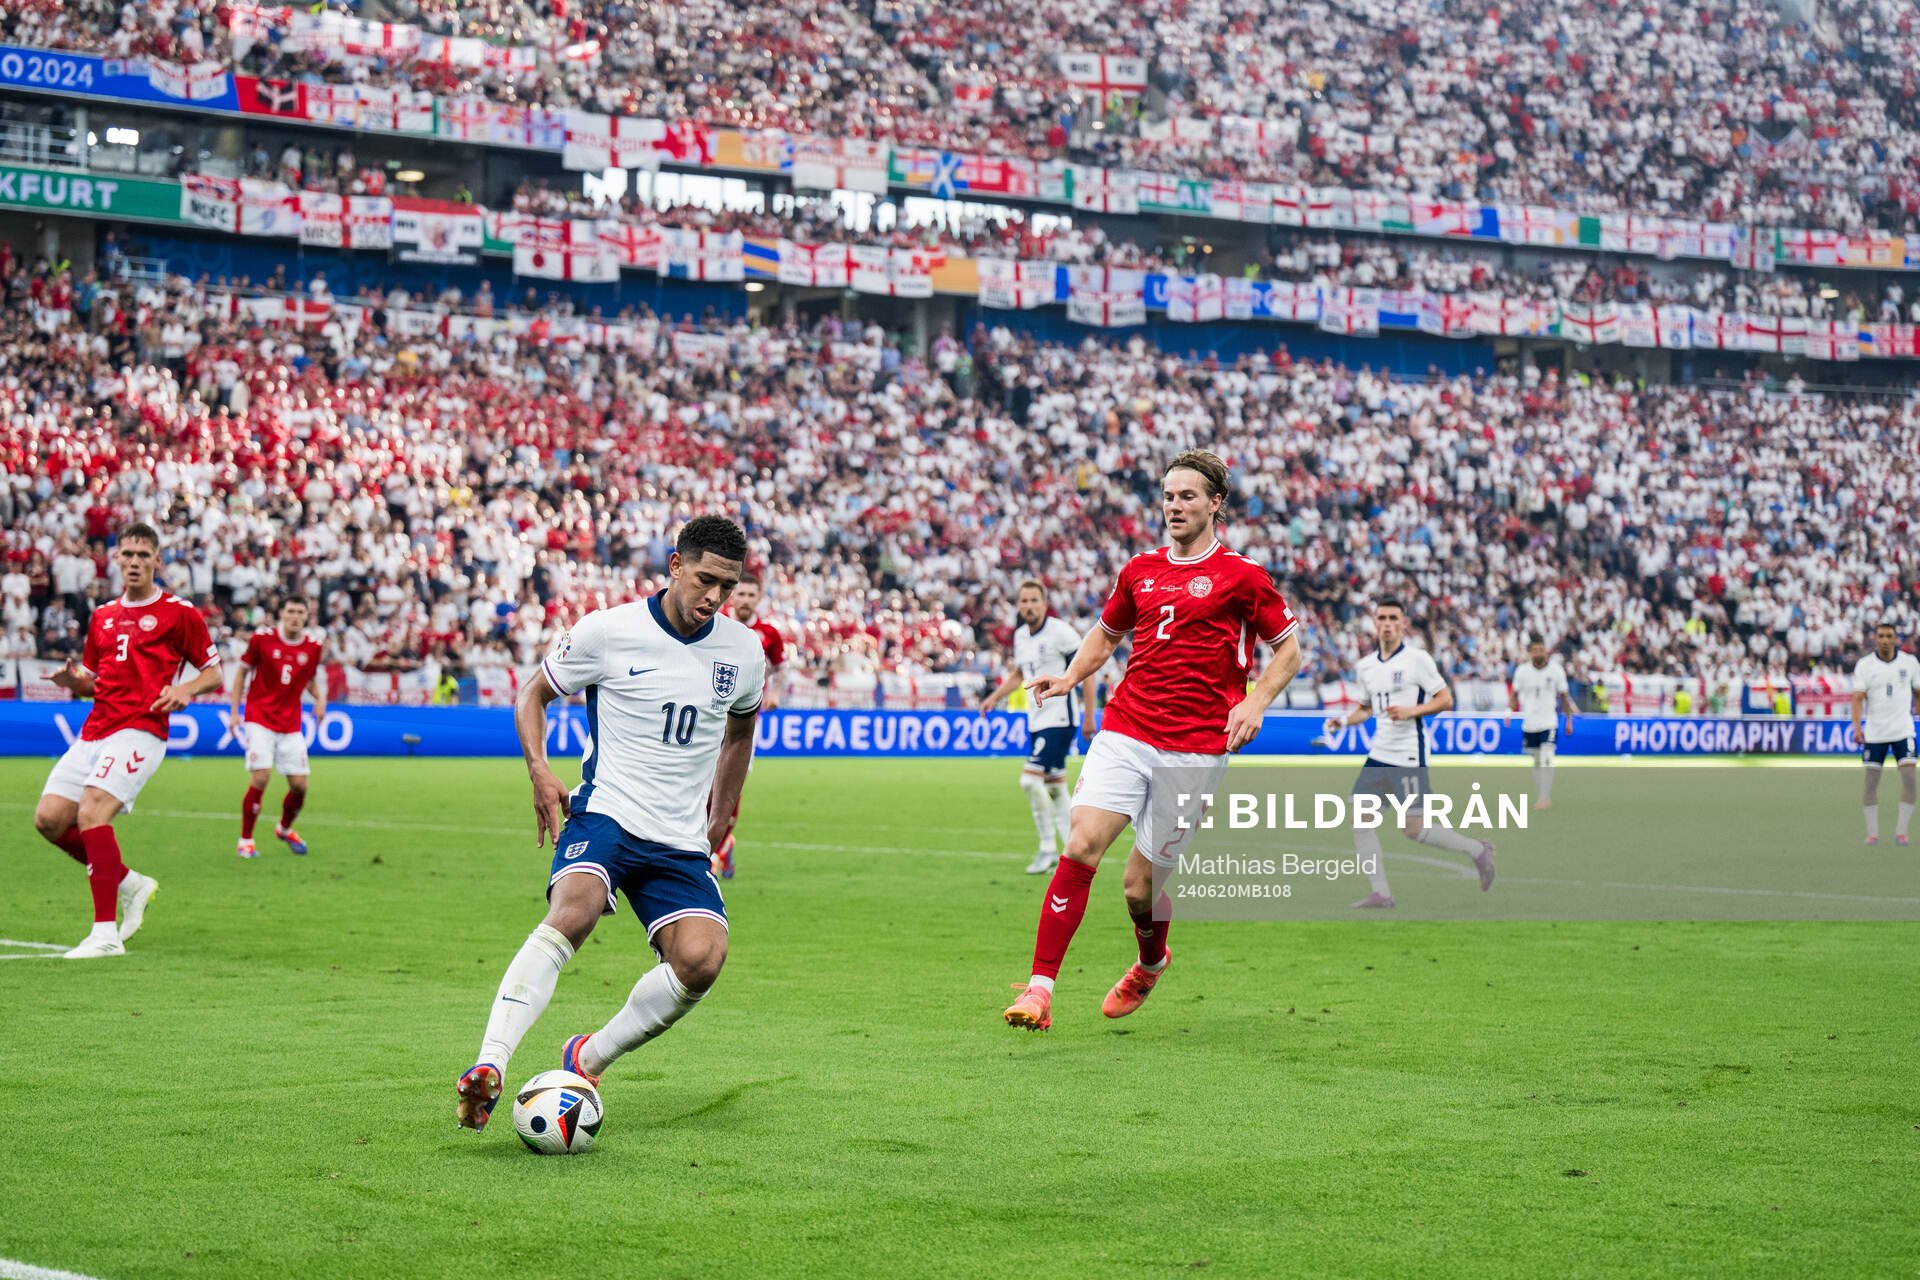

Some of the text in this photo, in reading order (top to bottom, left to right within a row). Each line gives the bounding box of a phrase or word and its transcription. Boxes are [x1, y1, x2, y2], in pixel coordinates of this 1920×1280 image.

[1156, 605, 1175, 639] 2
[115, 634, 130, 662] 3
[281, 664, 292, 685] 6
[662, 701, 698, 746] 10
[1615, 721, 1795, 752] PHOTOGRAPHY
[96, 756, 115, 778] 3
[1159, 826, 1185, 858] 2
